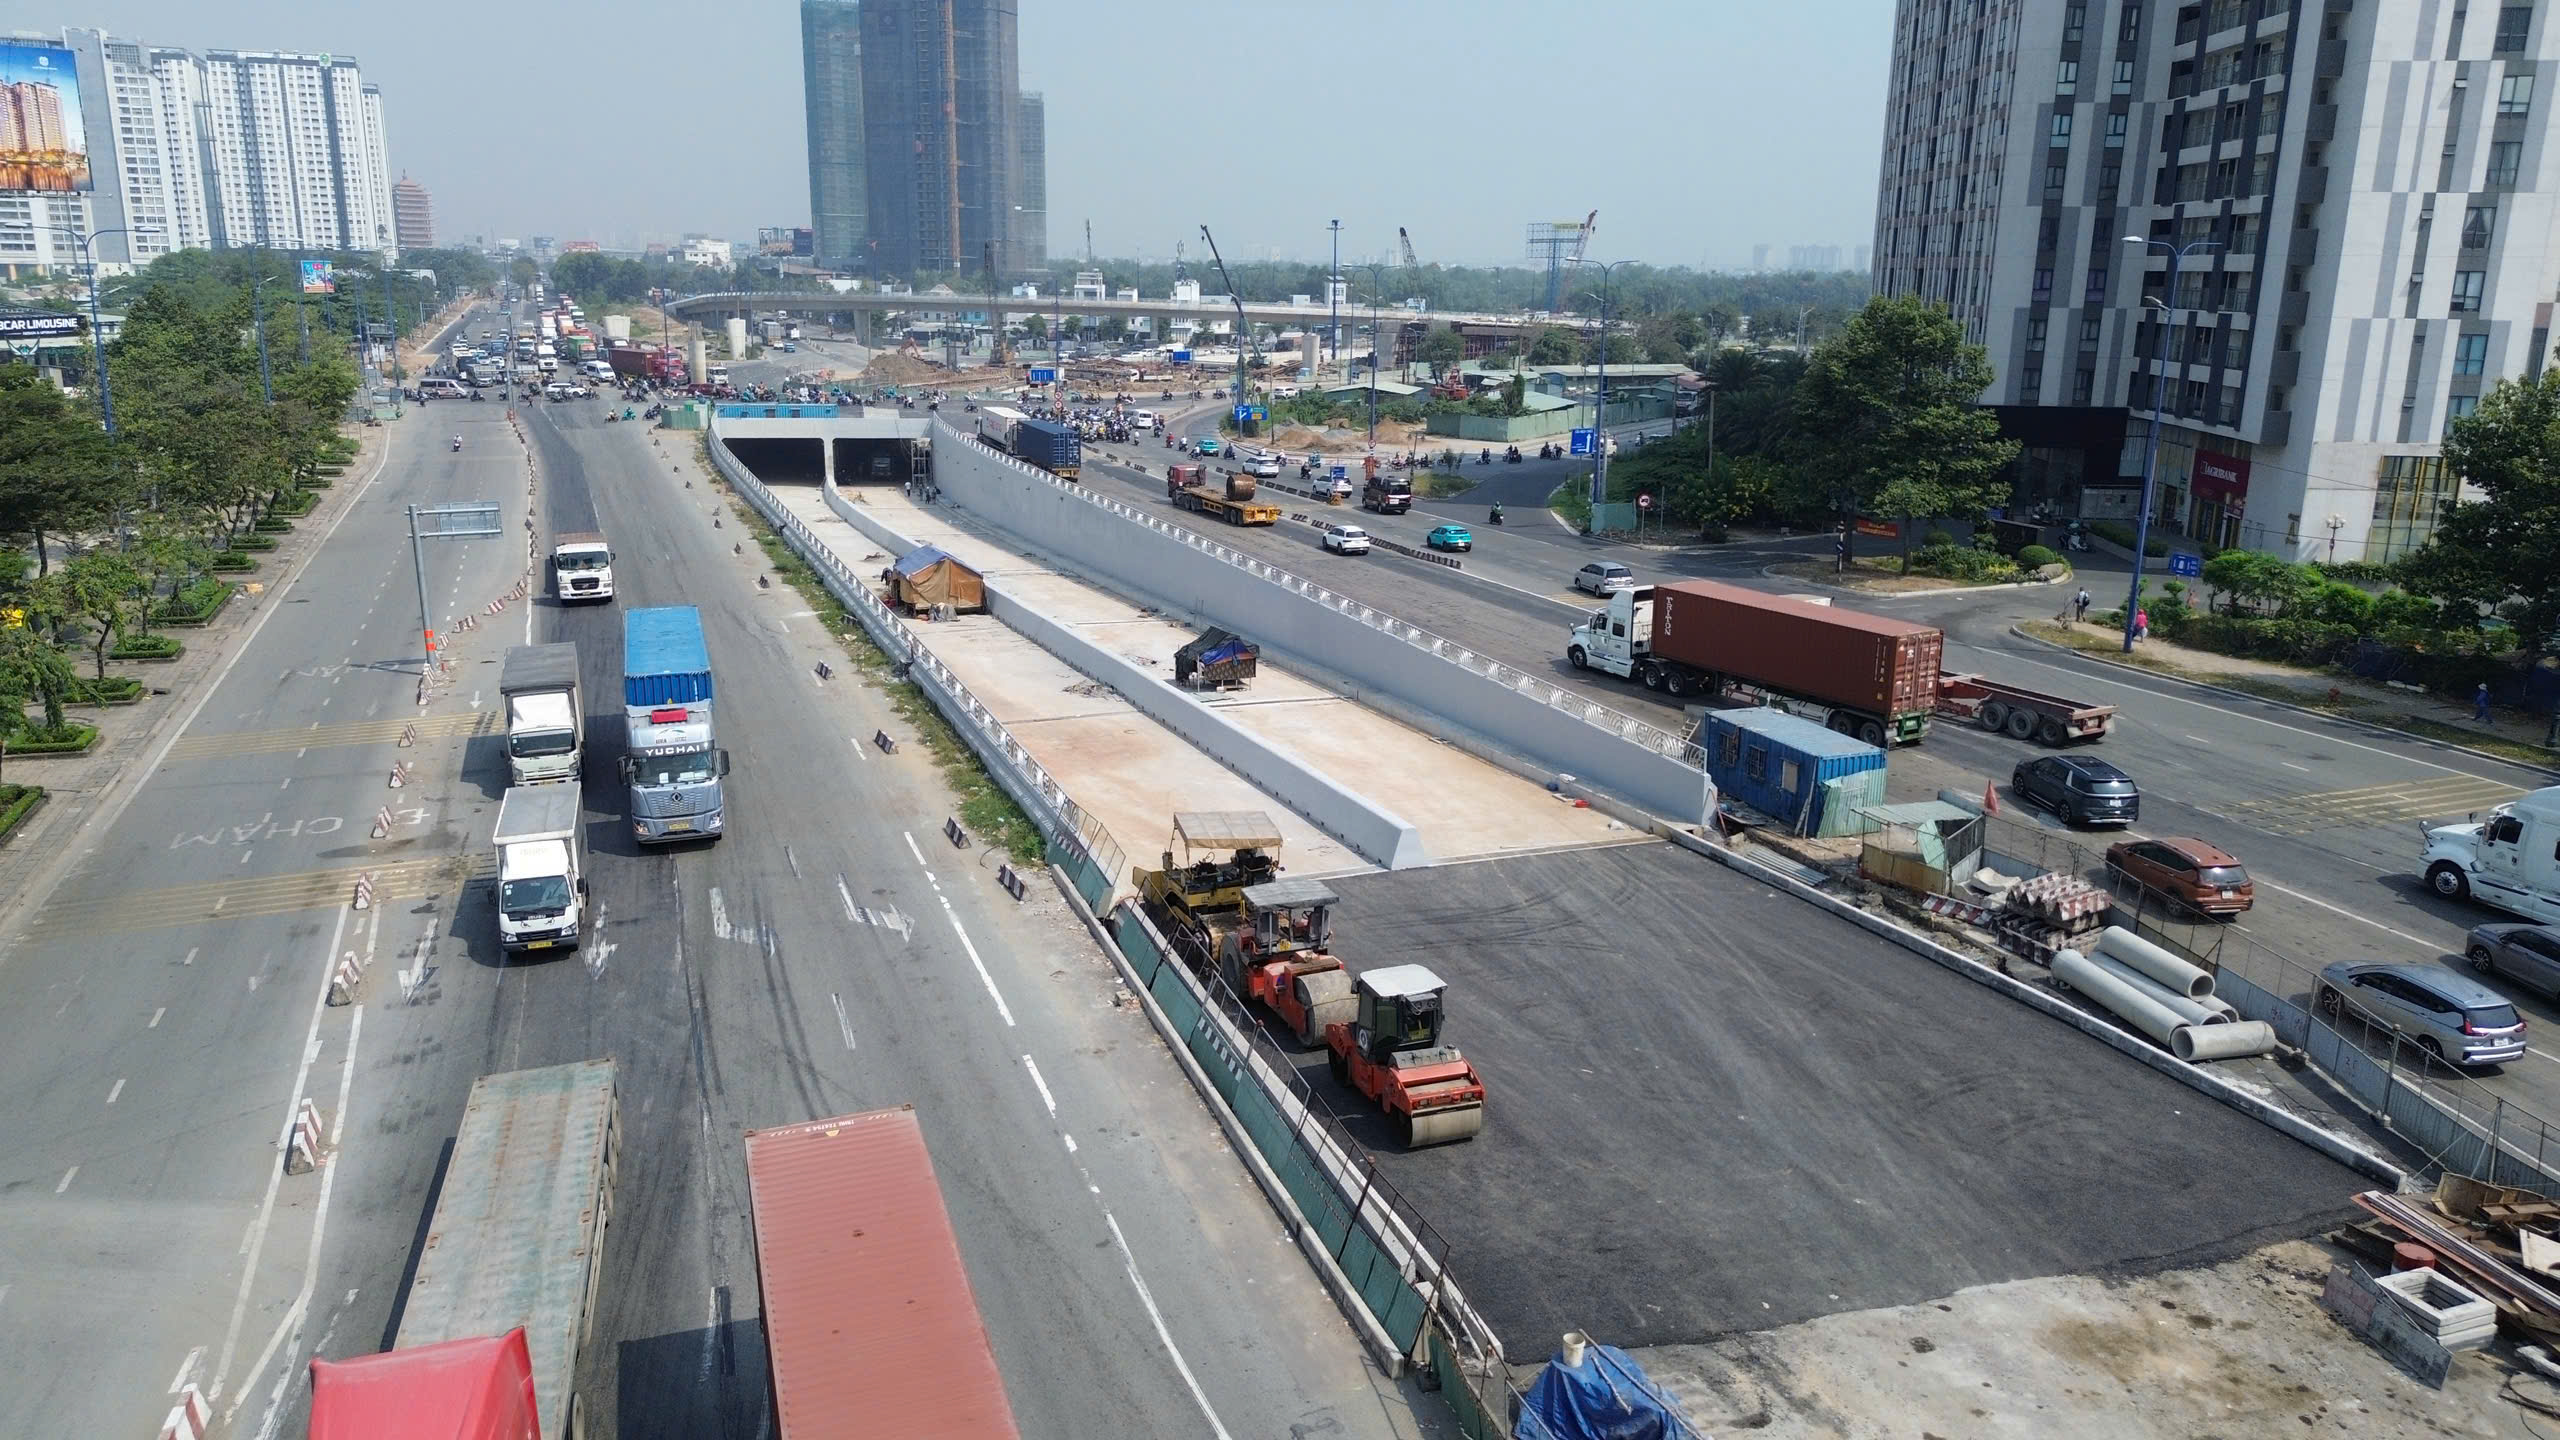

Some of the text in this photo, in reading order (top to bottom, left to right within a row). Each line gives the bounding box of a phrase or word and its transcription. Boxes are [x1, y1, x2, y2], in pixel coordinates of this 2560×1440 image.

[27, 318, 78, 329] LIMOUSINE
[1664, 596, 1673, 636] TRITON
[645, 745, 700, 756] YUCHAI
